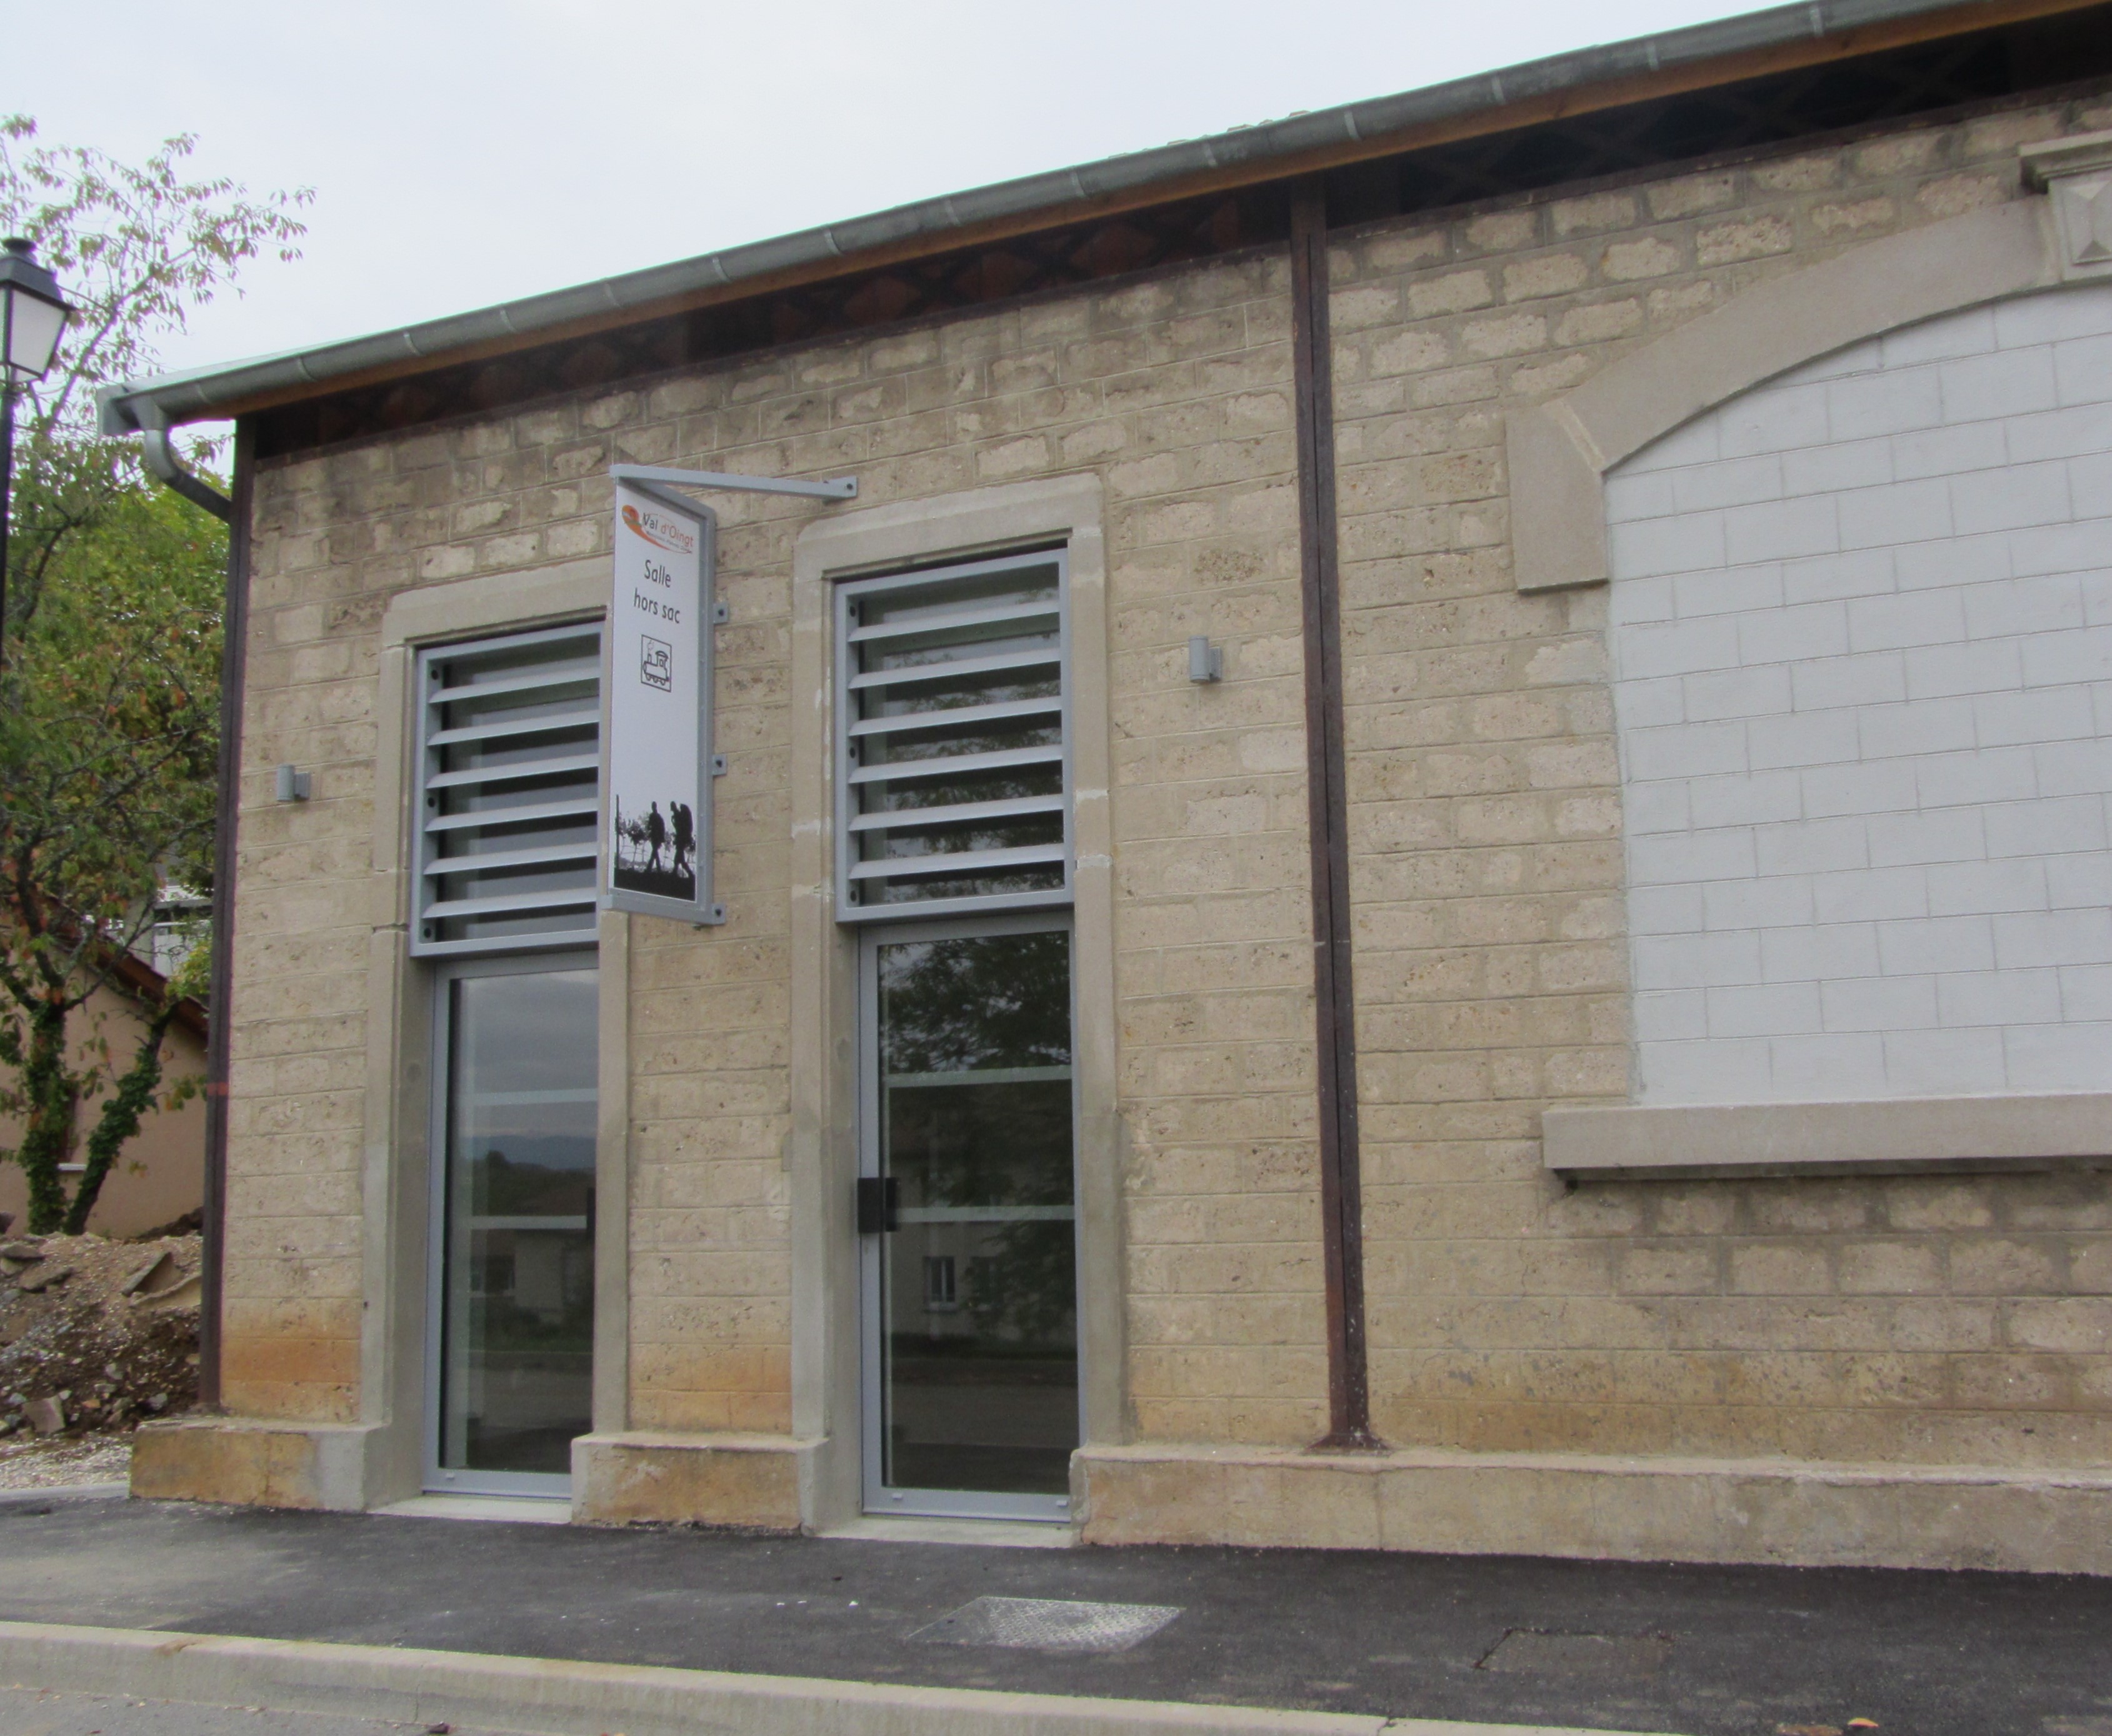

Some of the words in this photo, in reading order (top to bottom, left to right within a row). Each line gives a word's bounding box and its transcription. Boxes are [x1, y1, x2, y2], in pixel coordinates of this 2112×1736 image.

[643, 512, 658, 531] Val
[661, 523, 693, 547] d'Oingt
[644, 559, 671, 588] Salle
[634, 587, 658, 616] hors
[662, 605, 680, 624] sac
